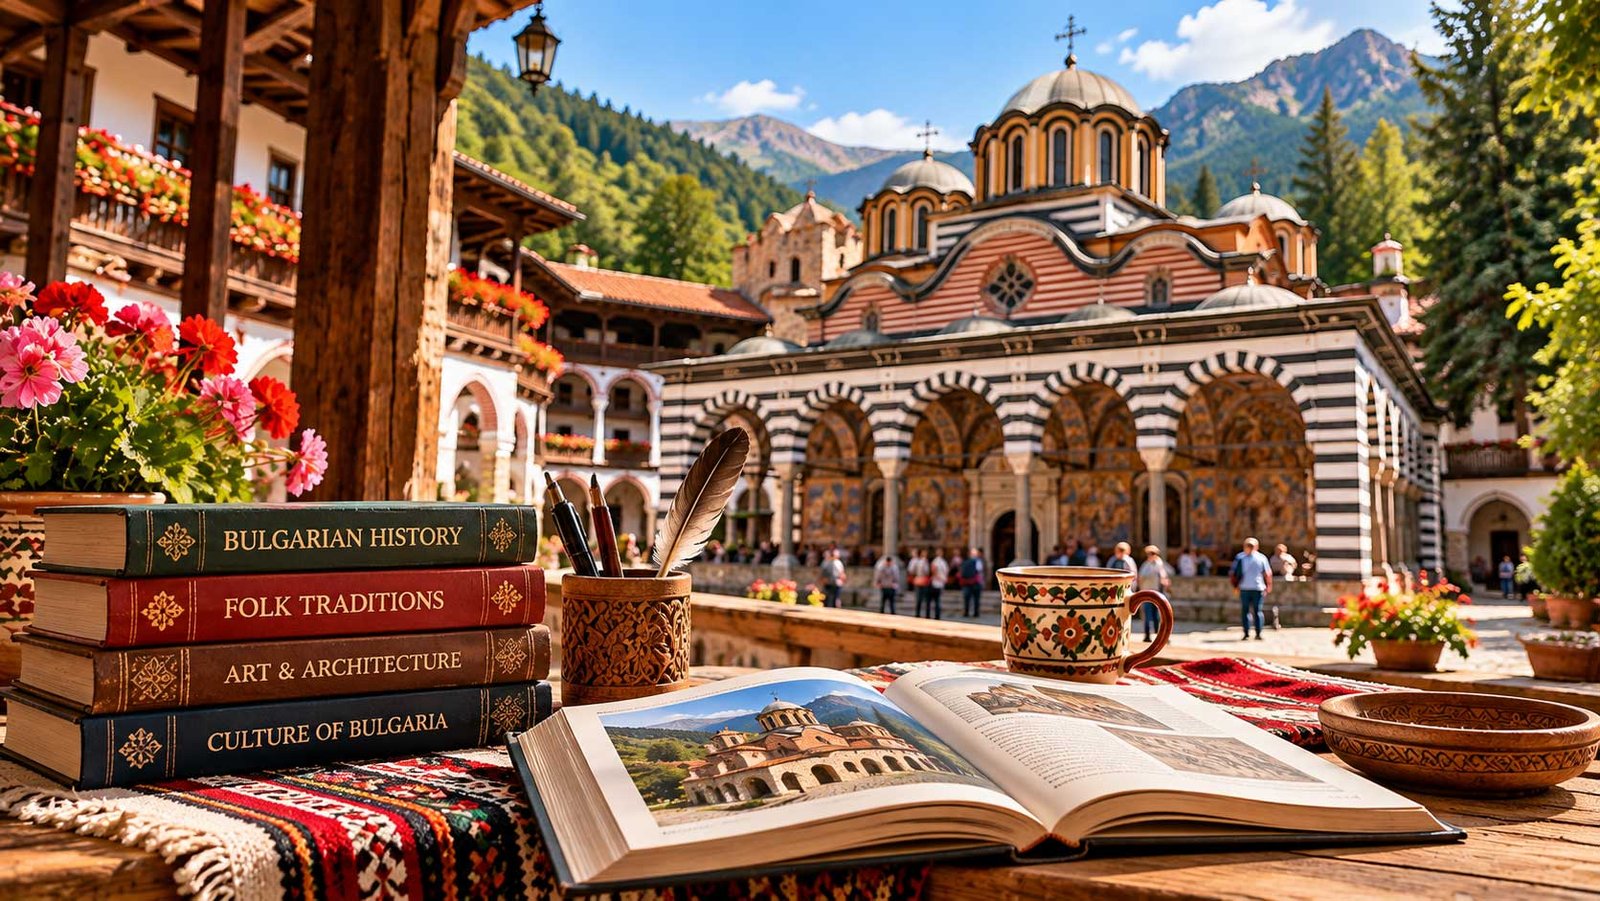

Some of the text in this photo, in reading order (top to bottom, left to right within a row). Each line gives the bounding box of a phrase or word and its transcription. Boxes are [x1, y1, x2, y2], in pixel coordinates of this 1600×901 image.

[223, 526, 463, 551] BULGARIAN HISTORY
[224, 590, 444, 619] FOLK TRADITIONS
[223, 651, 462, 684] ART & ARCHITECTURE
[207, 712, 448, 752] CULTURE OF BULGARIA
